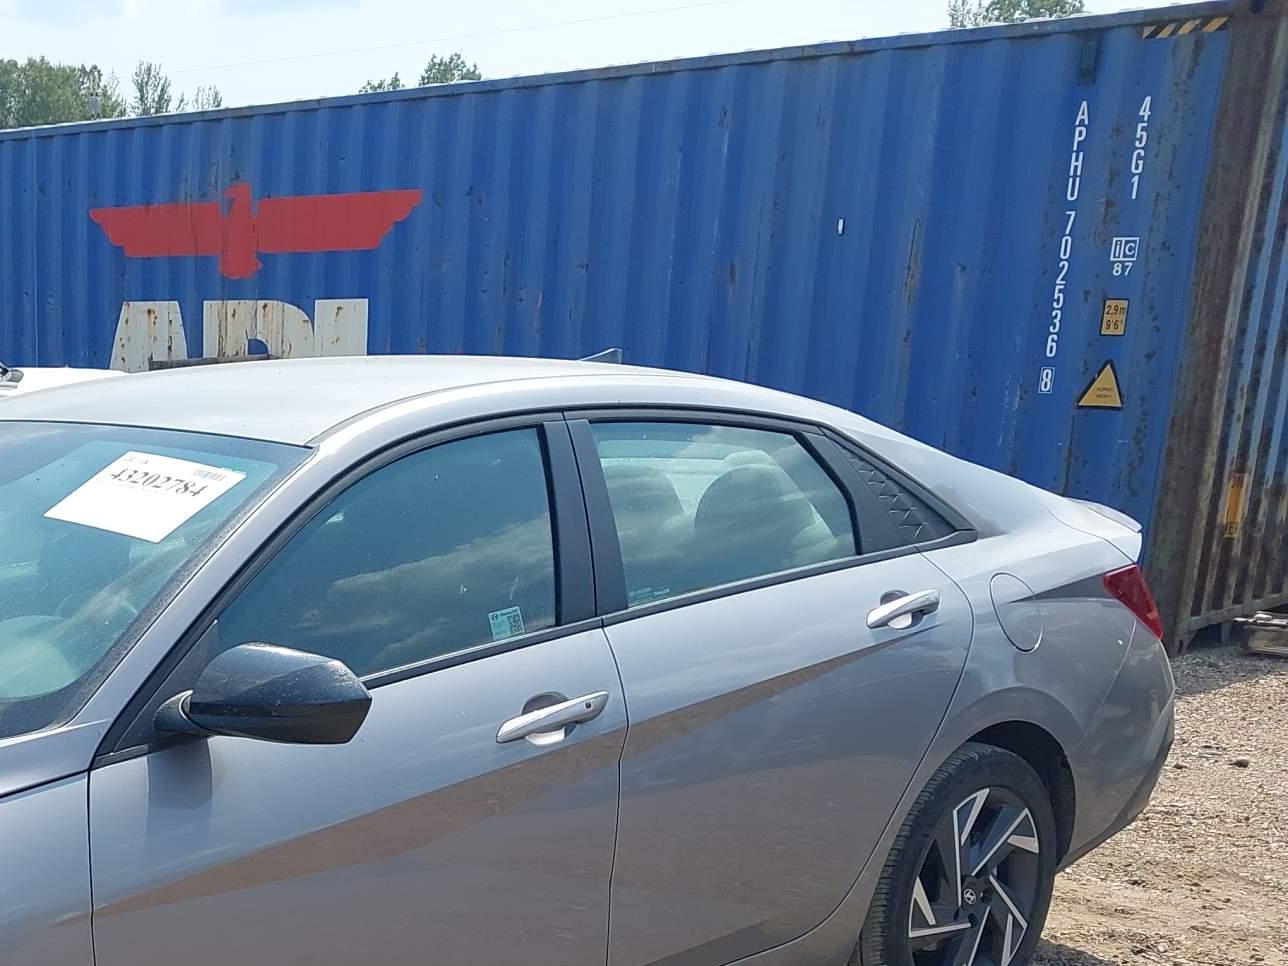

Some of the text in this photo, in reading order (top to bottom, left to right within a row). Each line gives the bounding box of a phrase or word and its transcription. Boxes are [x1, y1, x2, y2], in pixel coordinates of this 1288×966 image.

[1130, 95, 1152, 200] 45G1
[1040, 100, 1089, 392] APHU 702536 8
[1112, 262, 1133, 276] 87
[111, 467, 209, 497] 43202784
